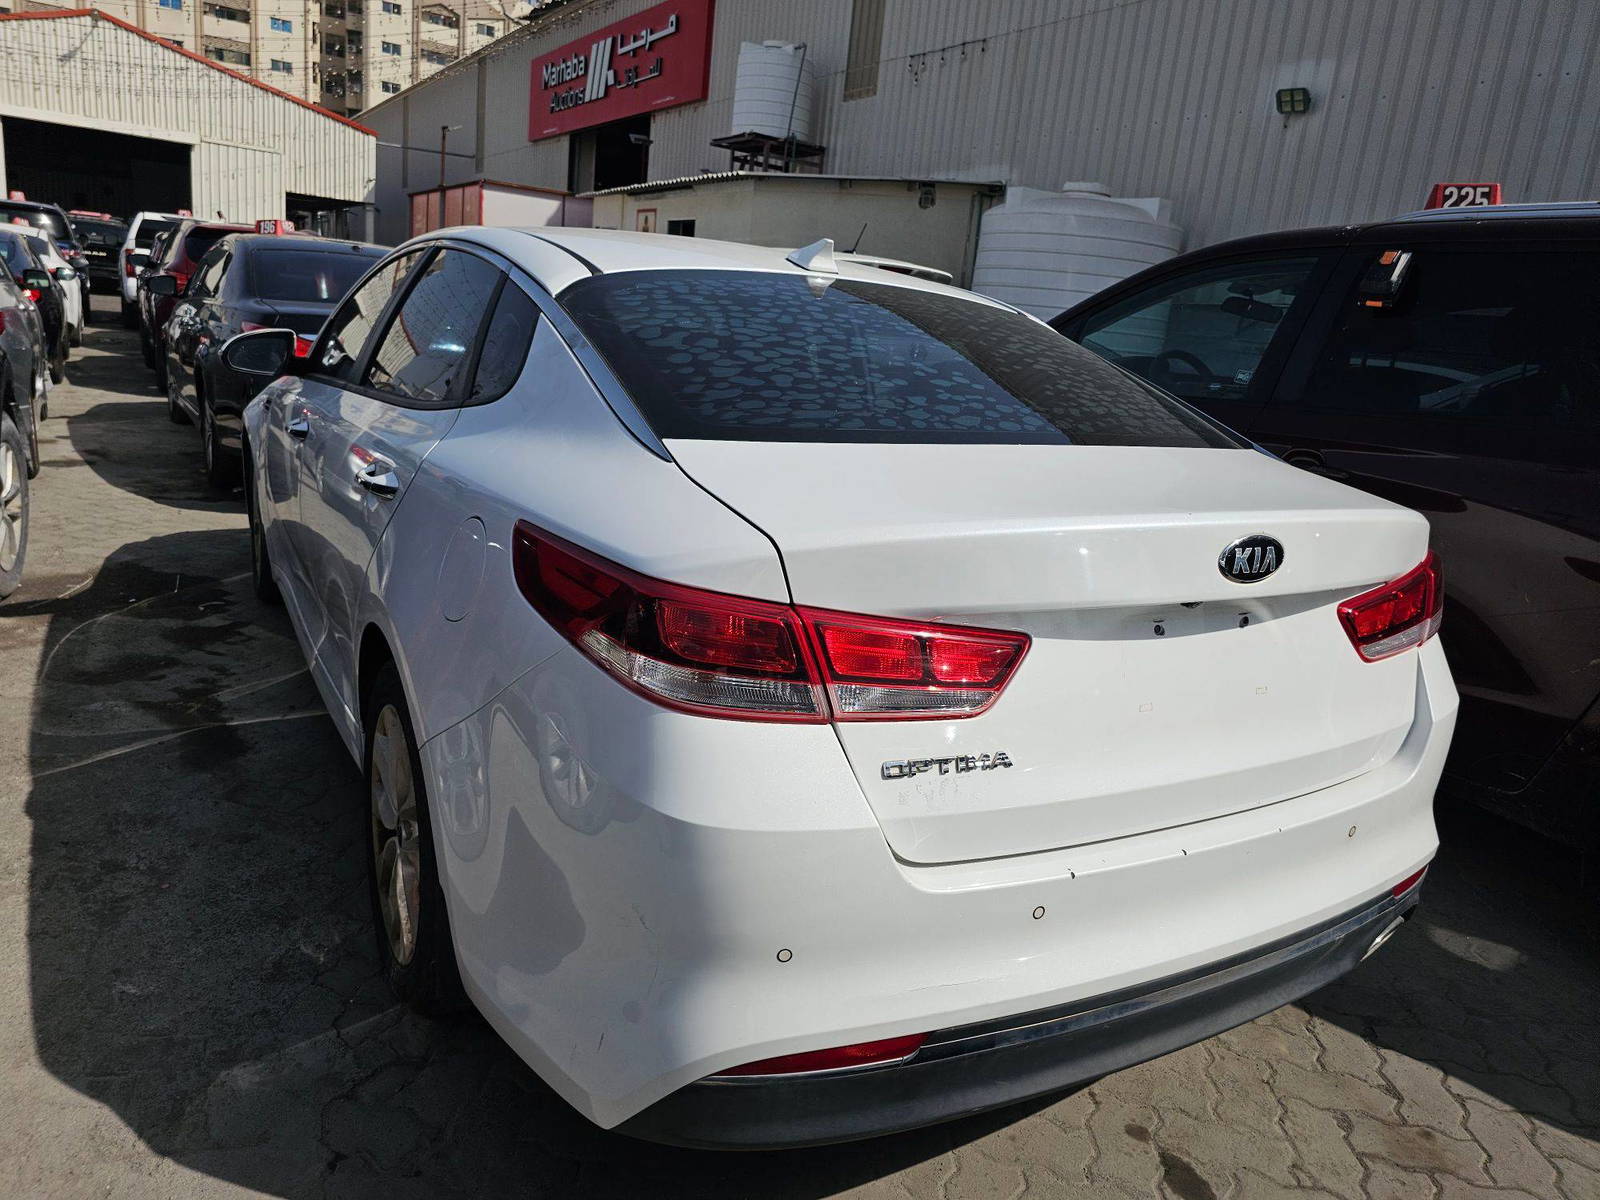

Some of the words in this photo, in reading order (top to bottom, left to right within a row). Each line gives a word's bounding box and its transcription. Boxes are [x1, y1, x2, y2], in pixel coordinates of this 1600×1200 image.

[617, 14, 677, 57] مرحبا
[543, 53, 585, 90] Marhaba
[550, 87, 586, 113] Auctions
[1442, 186, 1490, 208] 225
[260, 220, 276, 234] 196
[1232, 545, 1276, 574] KIA
[880, 751, 1013, 780] OPTIMA
